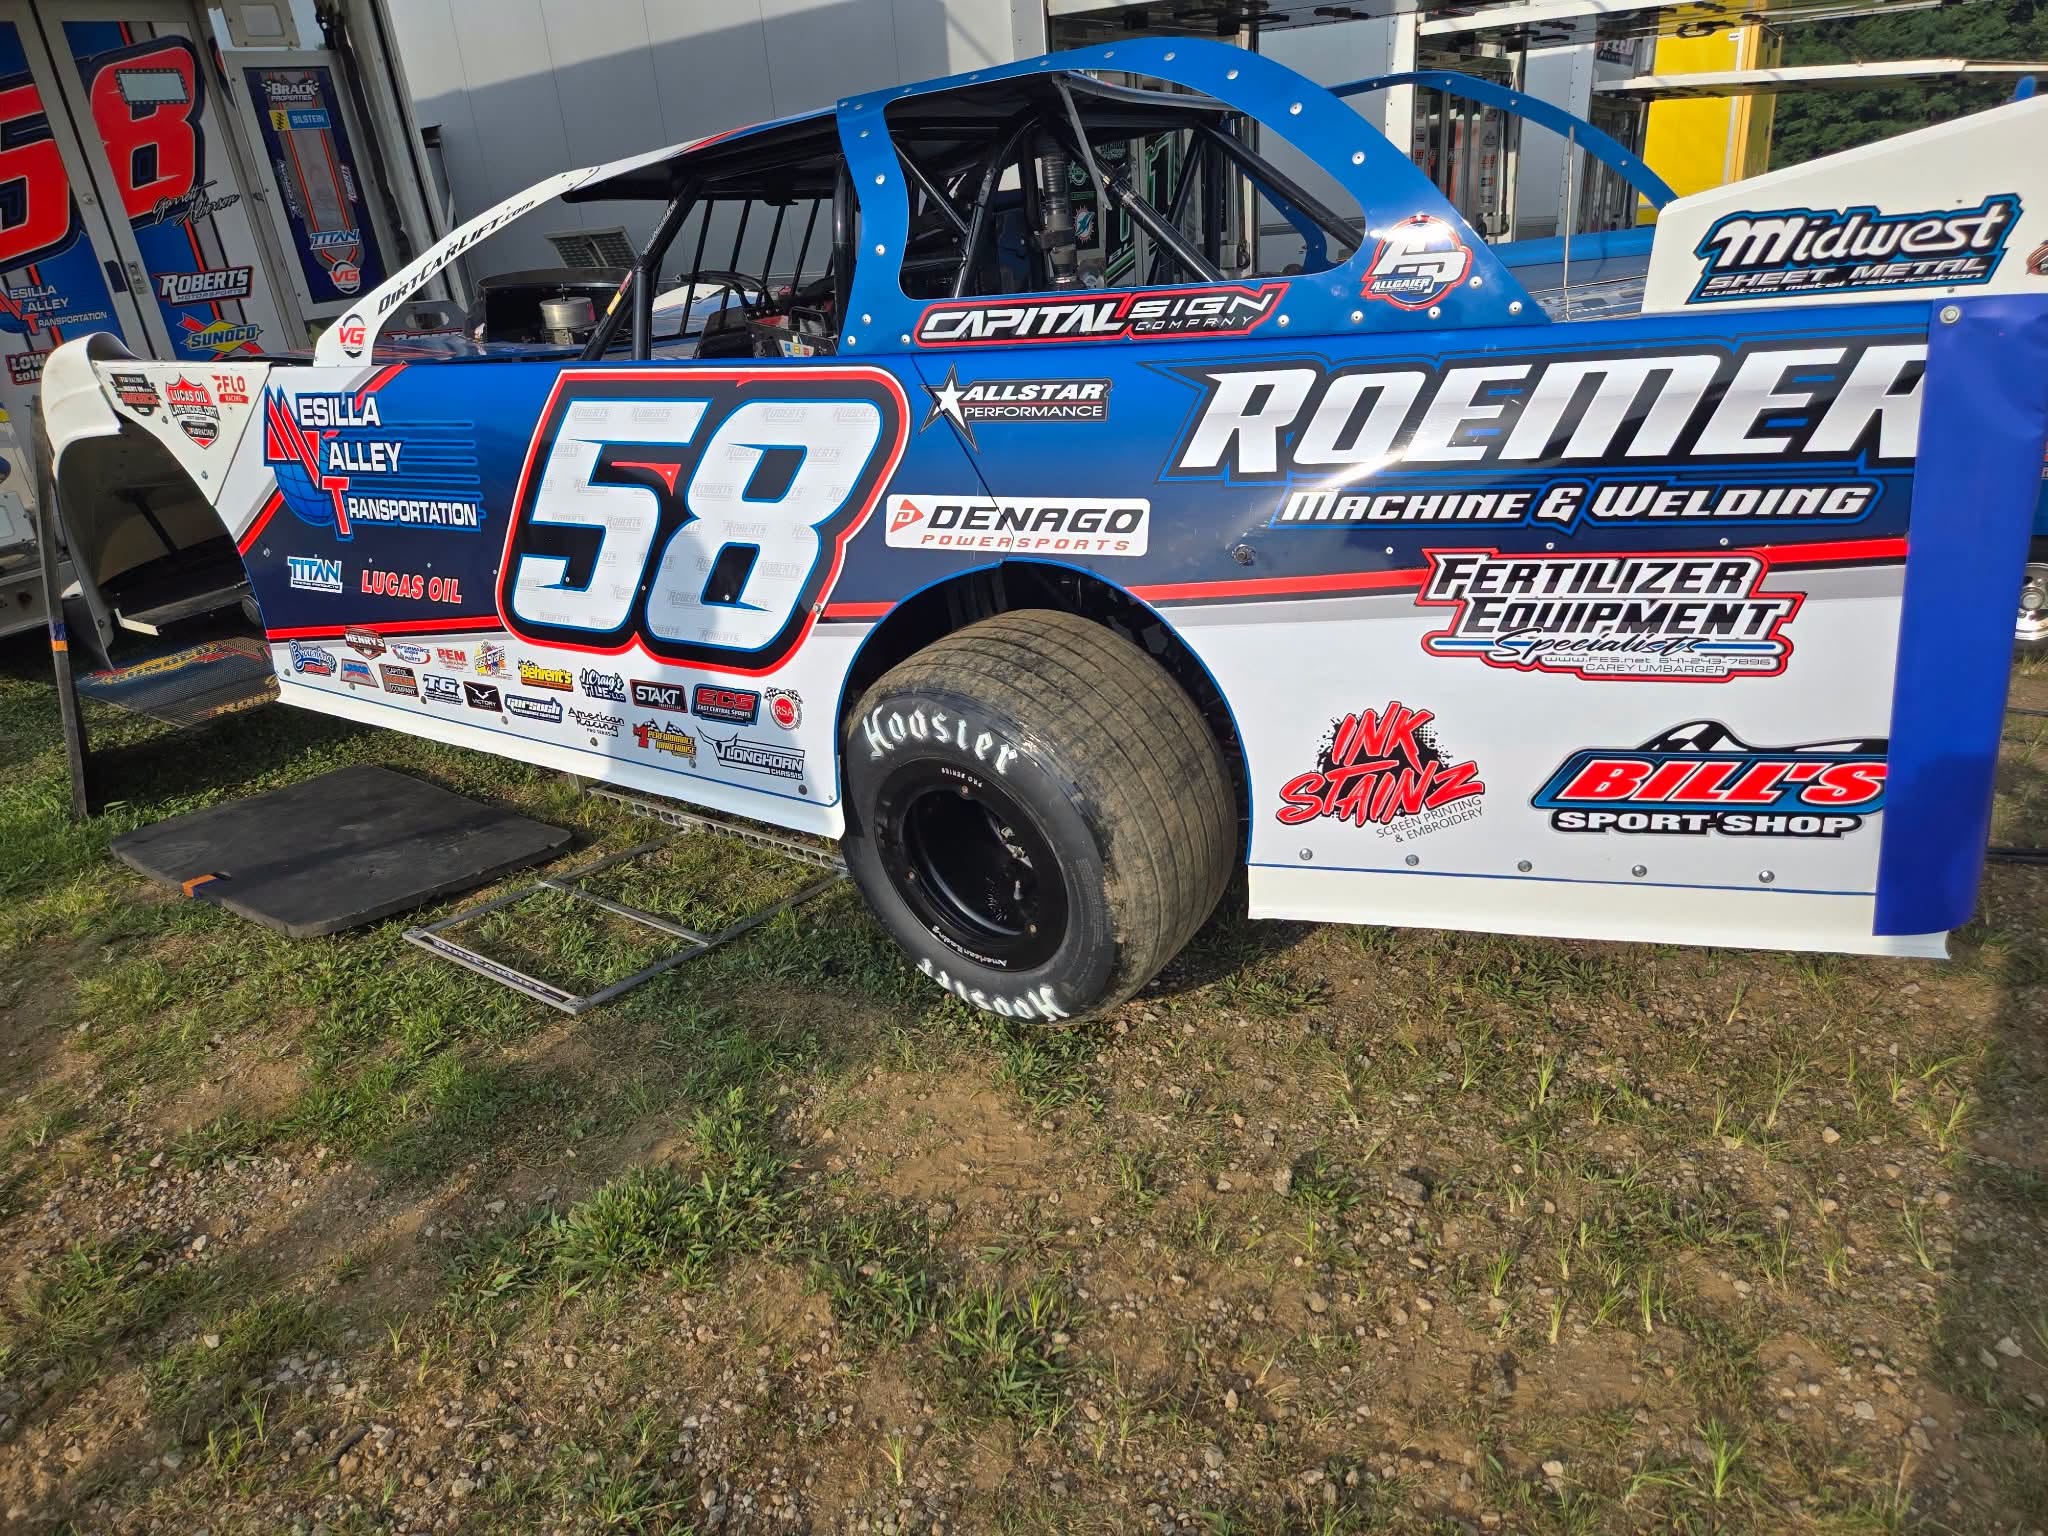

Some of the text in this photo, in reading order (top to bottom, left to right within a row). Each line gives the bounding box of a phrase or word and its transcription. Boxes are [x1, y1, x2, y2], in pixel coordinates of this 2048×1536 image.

[272, 82, 316, 96] BRACK
[292, 115, 325, 125] BILSTEIN
[311, 229, 359, 246] TITAN
[1711, 203, 2006, 268] Midwest
[160, 269, 249, 297] ROBERTS
[330, 267, 360, 283] VG
[1706, 257, 1988, 290] SHEET METAL
[177, 287, 245, 301] MOTORSPORTS
[1371, 278, 1435, 293] ALLGAIER
[1700, 286, 1779, 298] custom
[1785, 279, 1846, 291] metal
[920, 293, 1273, 340] CAPITAL SIGN
[1134, 314, 1256, 331] COMPANY
[190, 326, 258, 348] SUNOCO
[338, 327, 368, 346] VG
[222, 375, 247, 394] FLO
[962, 382, 1106, 402] ALLSTAR
[169, 389, 194, 403] LUCAS
[195, 390, 208, 404] OIL
[963, 404, 1104, 418] PERFORMANCE
[322, 476, 478, 535] TRANSPORTATION
[1280, 480, 1868, 526] MACHINE & WELDING
[513, 400, 883, 651] 58
[929, 504, 1145, 535] DENAGO
[920, 534, 1131, 552] POWERSPORTS
[288, 556, 342, 584] TITAN
[1433, 557, 1751, 595] FERTILIZER
[361, 570, 462, 604] LUCAS OIL
[1462, 597, 1783, 636] EQUIPMENT
[1493, 627, 1710, 660] Specialists
[437, 648, 466, 662] PEM
[521, 664, 573, 684] Behrent's
[1586, 663, 1725, 674] CAREY UMBARGER
[424, 675, 460, 695] TG
[582, 683, 609, 697] TILE
[635, 685, 680, 705] STAKT
[472, 698, 497, 707] VICTORY
[697, 688, 755, 711] ECS
[568, 707, 625, 726] American
[775, 706, 794, 718] RSA
[577, 717, 618, 737] Racing
[648, 730, 696, 746] PERFORMANCE
[863, 703, 1019, 776] Hoosier
[1331, 701, 1435, 776] INK
[726, 747, 805, 772] LONGHORN
[771, 769, 803, 780] CHASSIS
[1556, 759, 1888, 805] BILL'S
[1275, 758, 1486, 828] STAINZ
[1376, 795, 1483, 839] SCREEN PRINTING
[1394, 805, 1485, 843] & EMBROIDERY
[1557, 813, 1860, 836] SPORT SHOP
